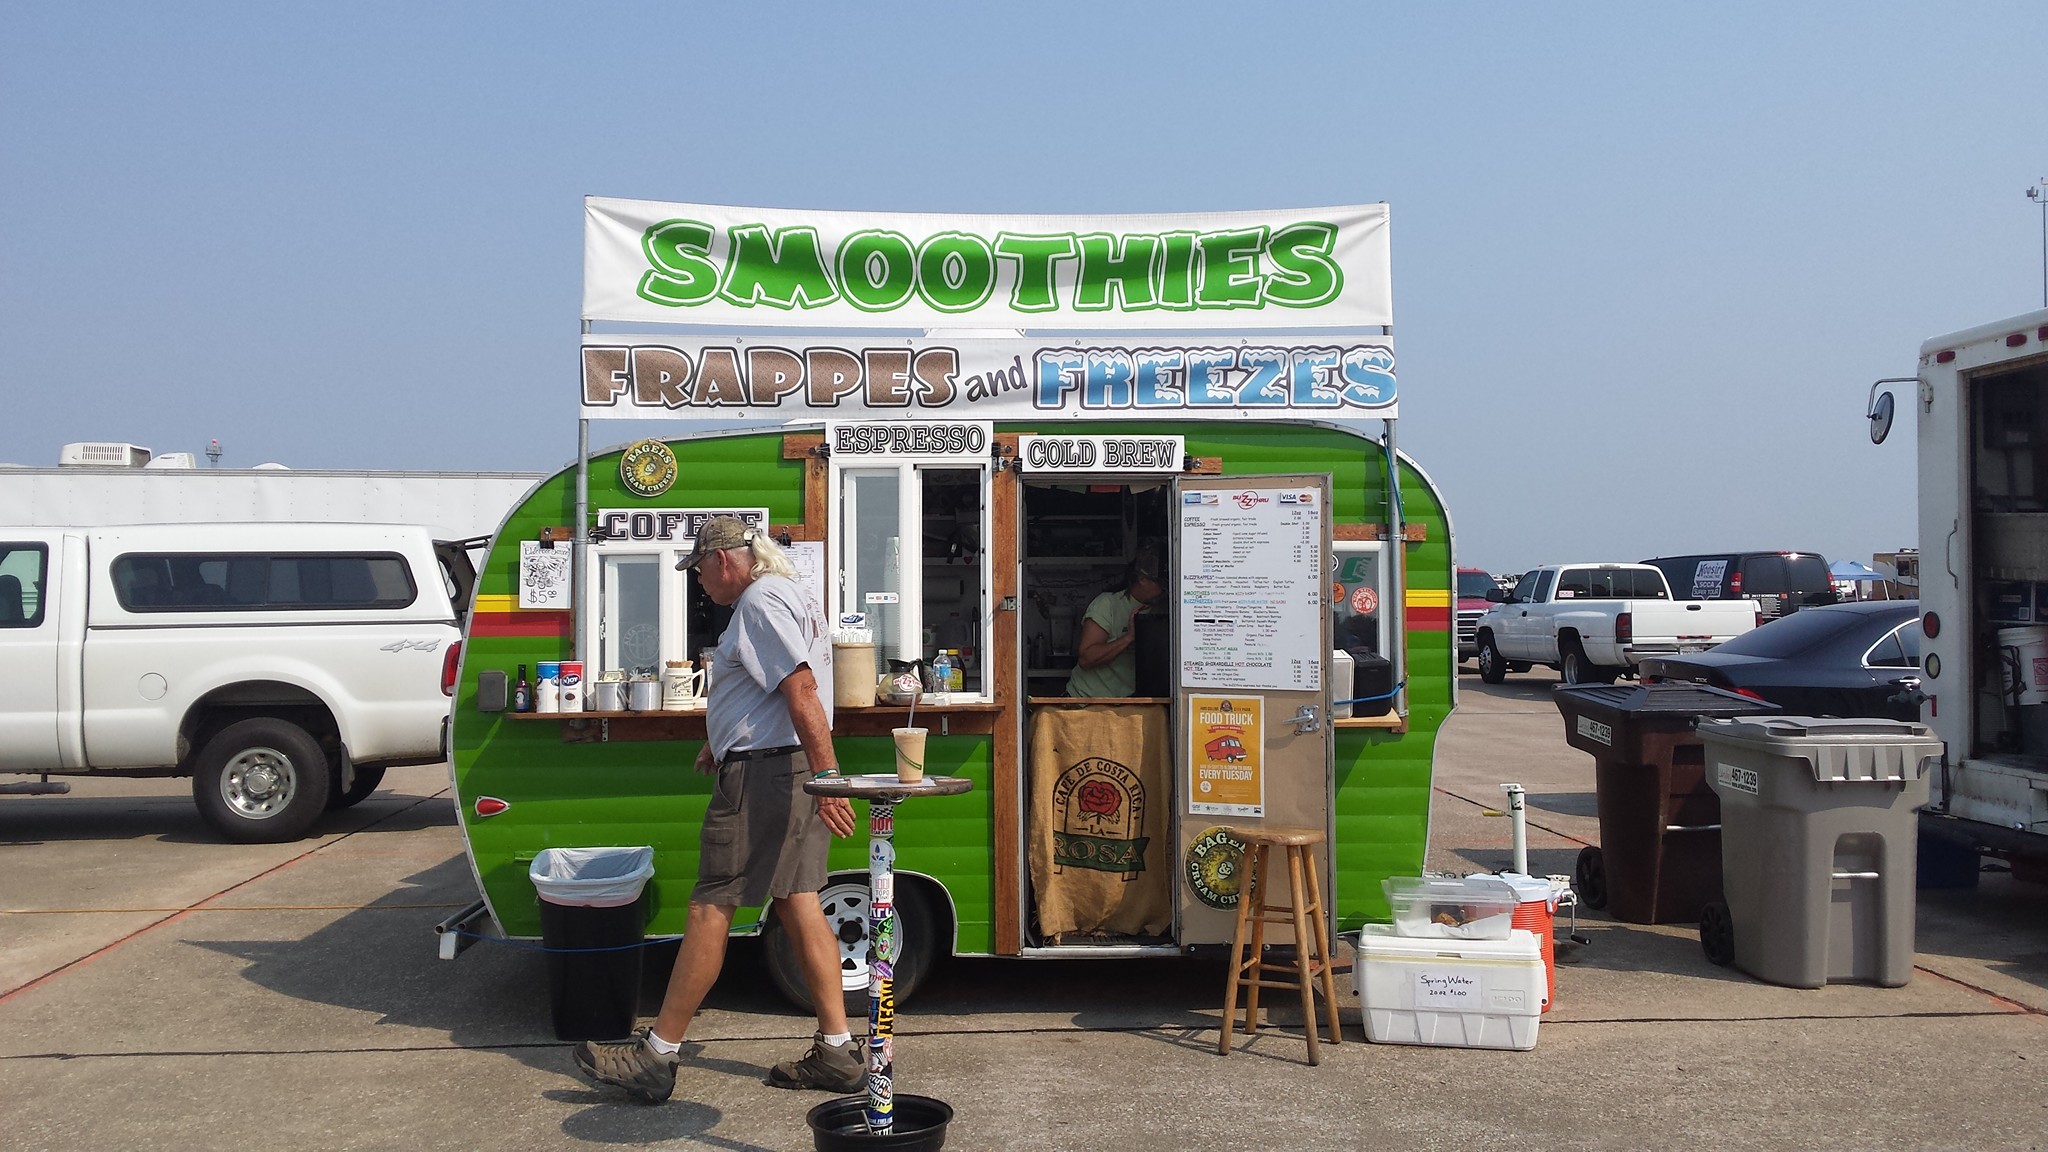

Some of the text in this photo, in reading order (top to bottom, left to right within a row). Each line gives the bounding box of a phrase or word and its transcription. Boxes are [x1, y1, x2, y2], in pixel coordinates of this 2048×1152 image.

[637, 219, 1344, 313] SMOOTHIES
[581, 344, 1397, 410] FRAPPES and FREEZES
[834, 424, 985, 454] ESPRESSO
[628, 444, 672, 464] BAGELS
[1027, 439, 1177, 469] COLD BREW
[626, 466, 673, 491] CREAM CHEESE
[605, 511, 762, 540] COFFE
[1200, 712, 1253, 725] FOOD TRUCK
[1590, 721, 1611, 739] 467-1239
[1056, 761, 1143, 813] CAFE DE COSTA RICA
[1200, 769, 1253, 780] EVERY TUESDAY
[1732, 768, 1756, 787] 467-1239
[1090, 825, 1104, 836] LA
[1054, 837, 1141, 864] ROSA
[1194, 833, 1246, 858] BAGEL
[1192, 863, 1218, 901] CREAM
[1420, 975, 1474, 988] Spring Water
[878, 979, 894, 1036] MEOW
